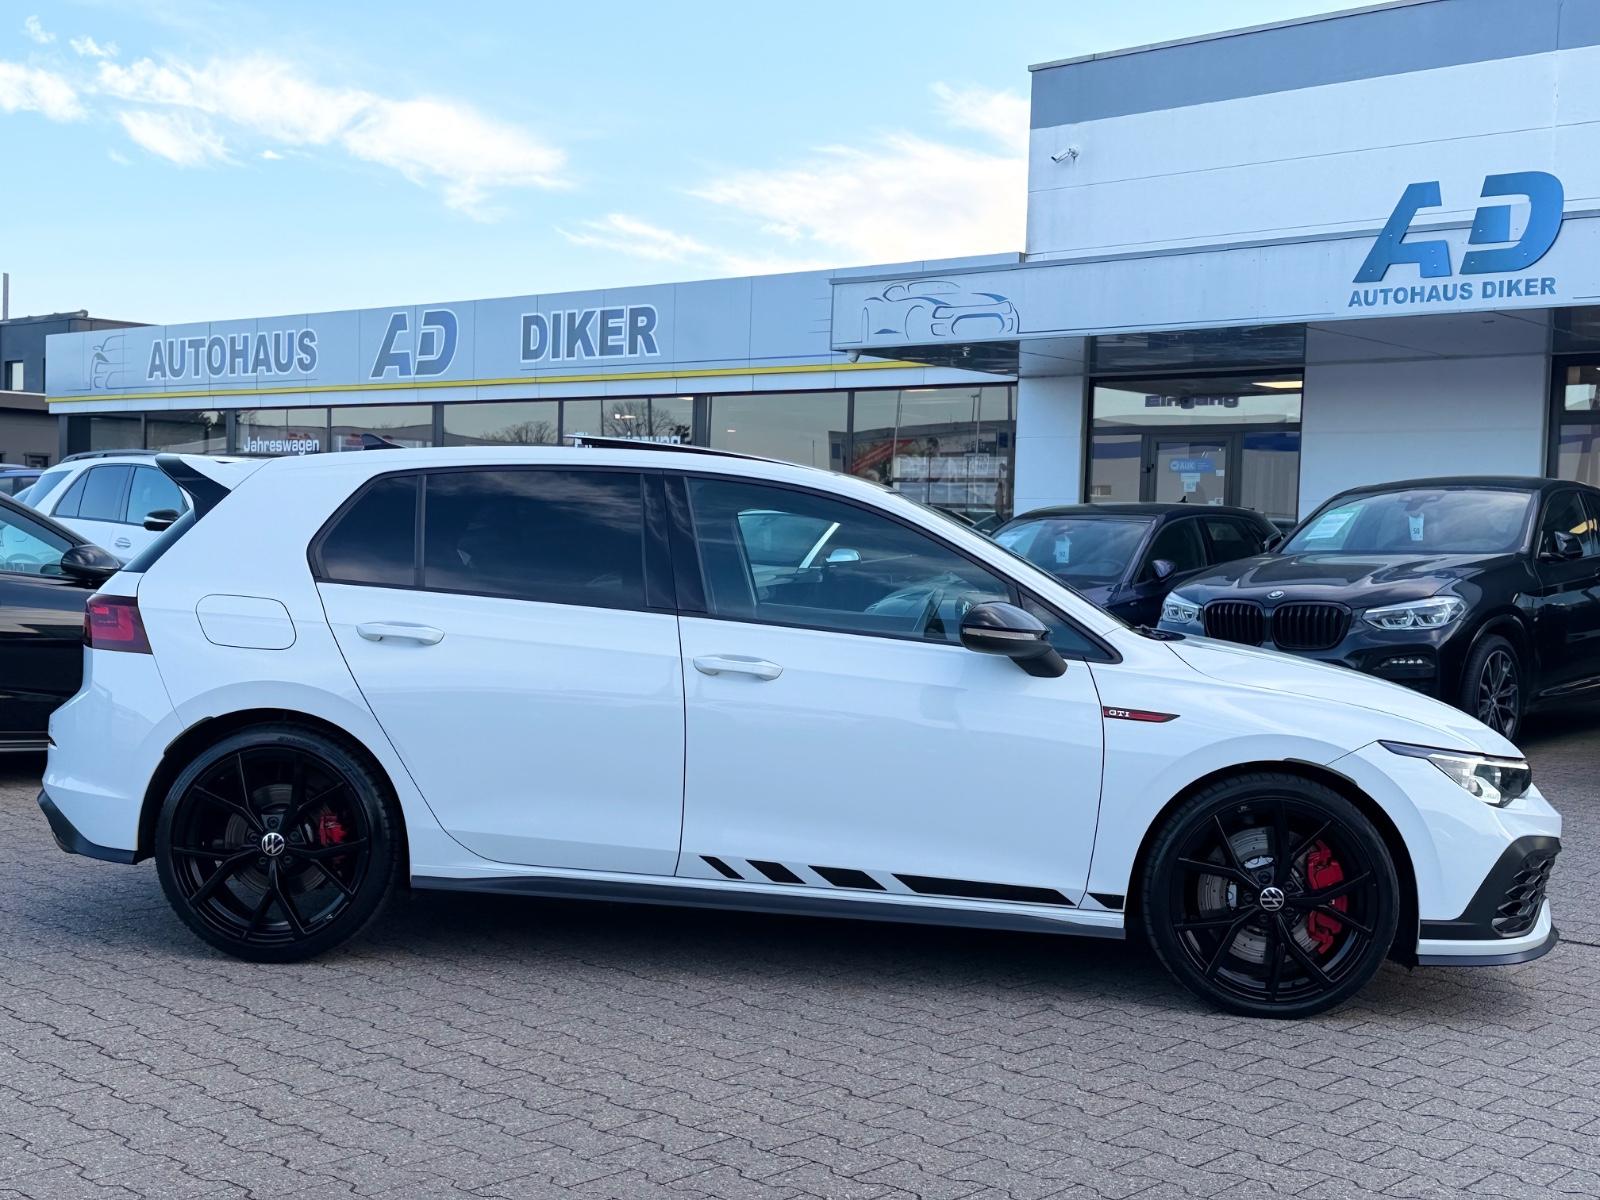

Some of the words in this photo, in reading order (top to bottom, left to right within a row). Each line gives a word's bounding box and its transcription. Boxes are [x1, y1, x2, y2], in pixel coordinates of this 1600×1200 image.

[1352, 171, 1565, 283] AD
[1348, 281, 1473, 307] AUTOHAUS
[1481, 276, 1556, 299] DIKER
[146, 329, 319, 380] AUTOHAUS
[369, 309, 459, 380] AD
[520, 303, 661, 363] DIKER
[243, 436, 320, 456] Jahreswagen
[1108, 709, 1130, 718] GTI
